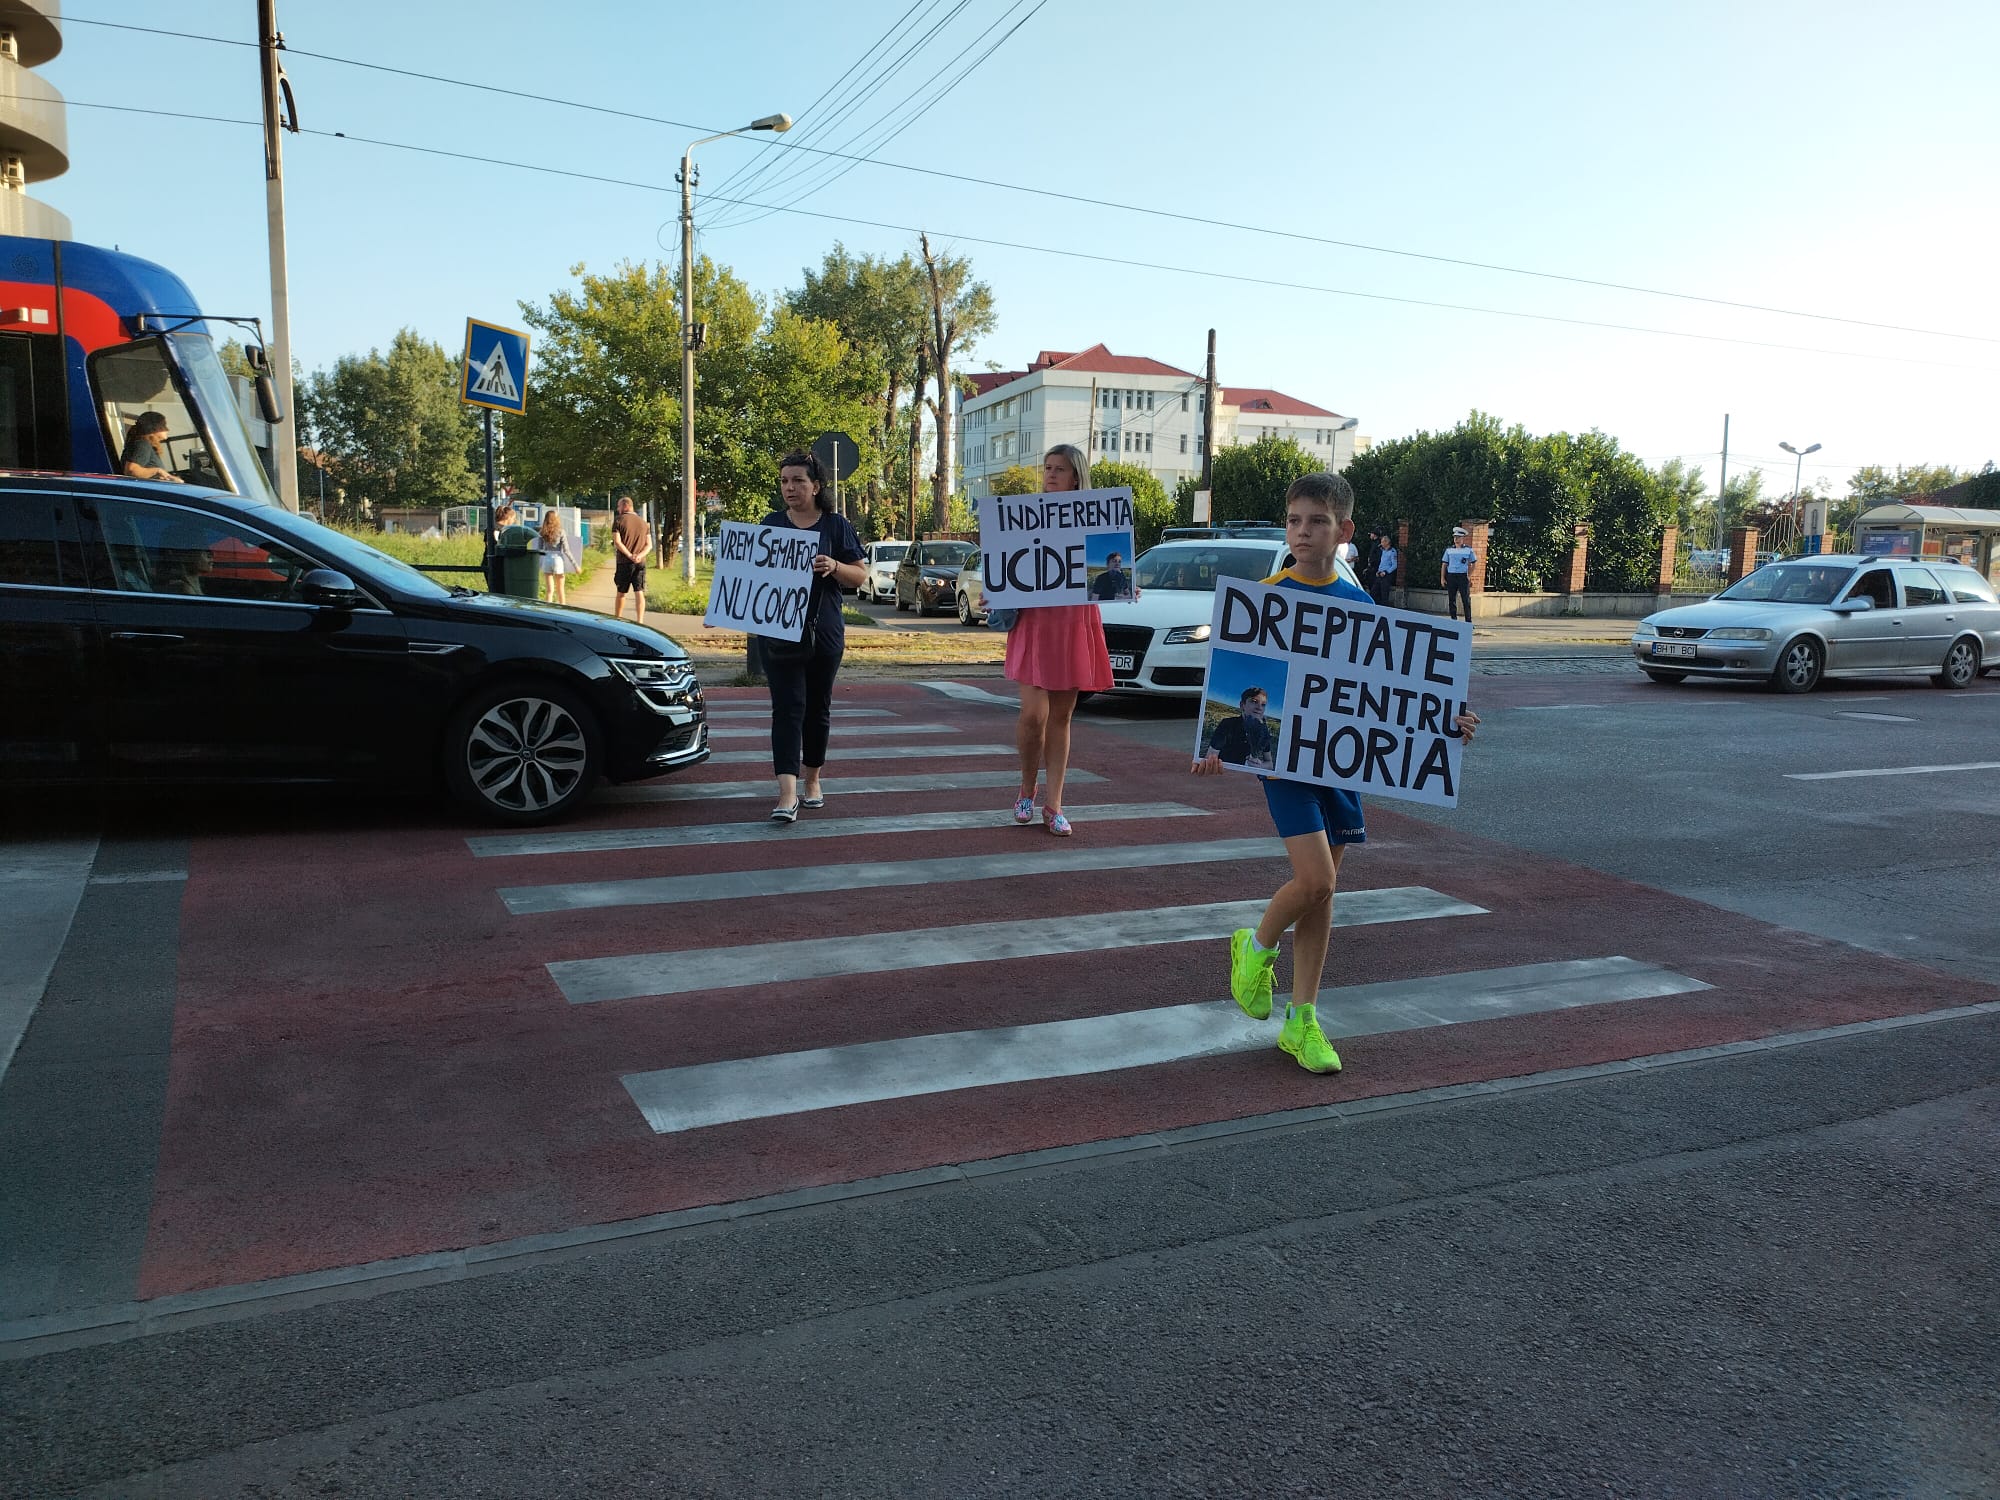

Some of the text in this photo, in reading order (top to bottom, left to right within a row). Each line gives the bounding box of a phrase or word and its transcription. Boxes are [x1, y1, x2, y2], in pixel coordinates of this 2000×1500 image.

[720, 528, 819, 573] VREM SEMAFOR
[714, 575, 808, 630] NU COVOR
[1220, 586, 1460, 686] DREPTATE
[1300, 673, 1467, 739] PENTRU
